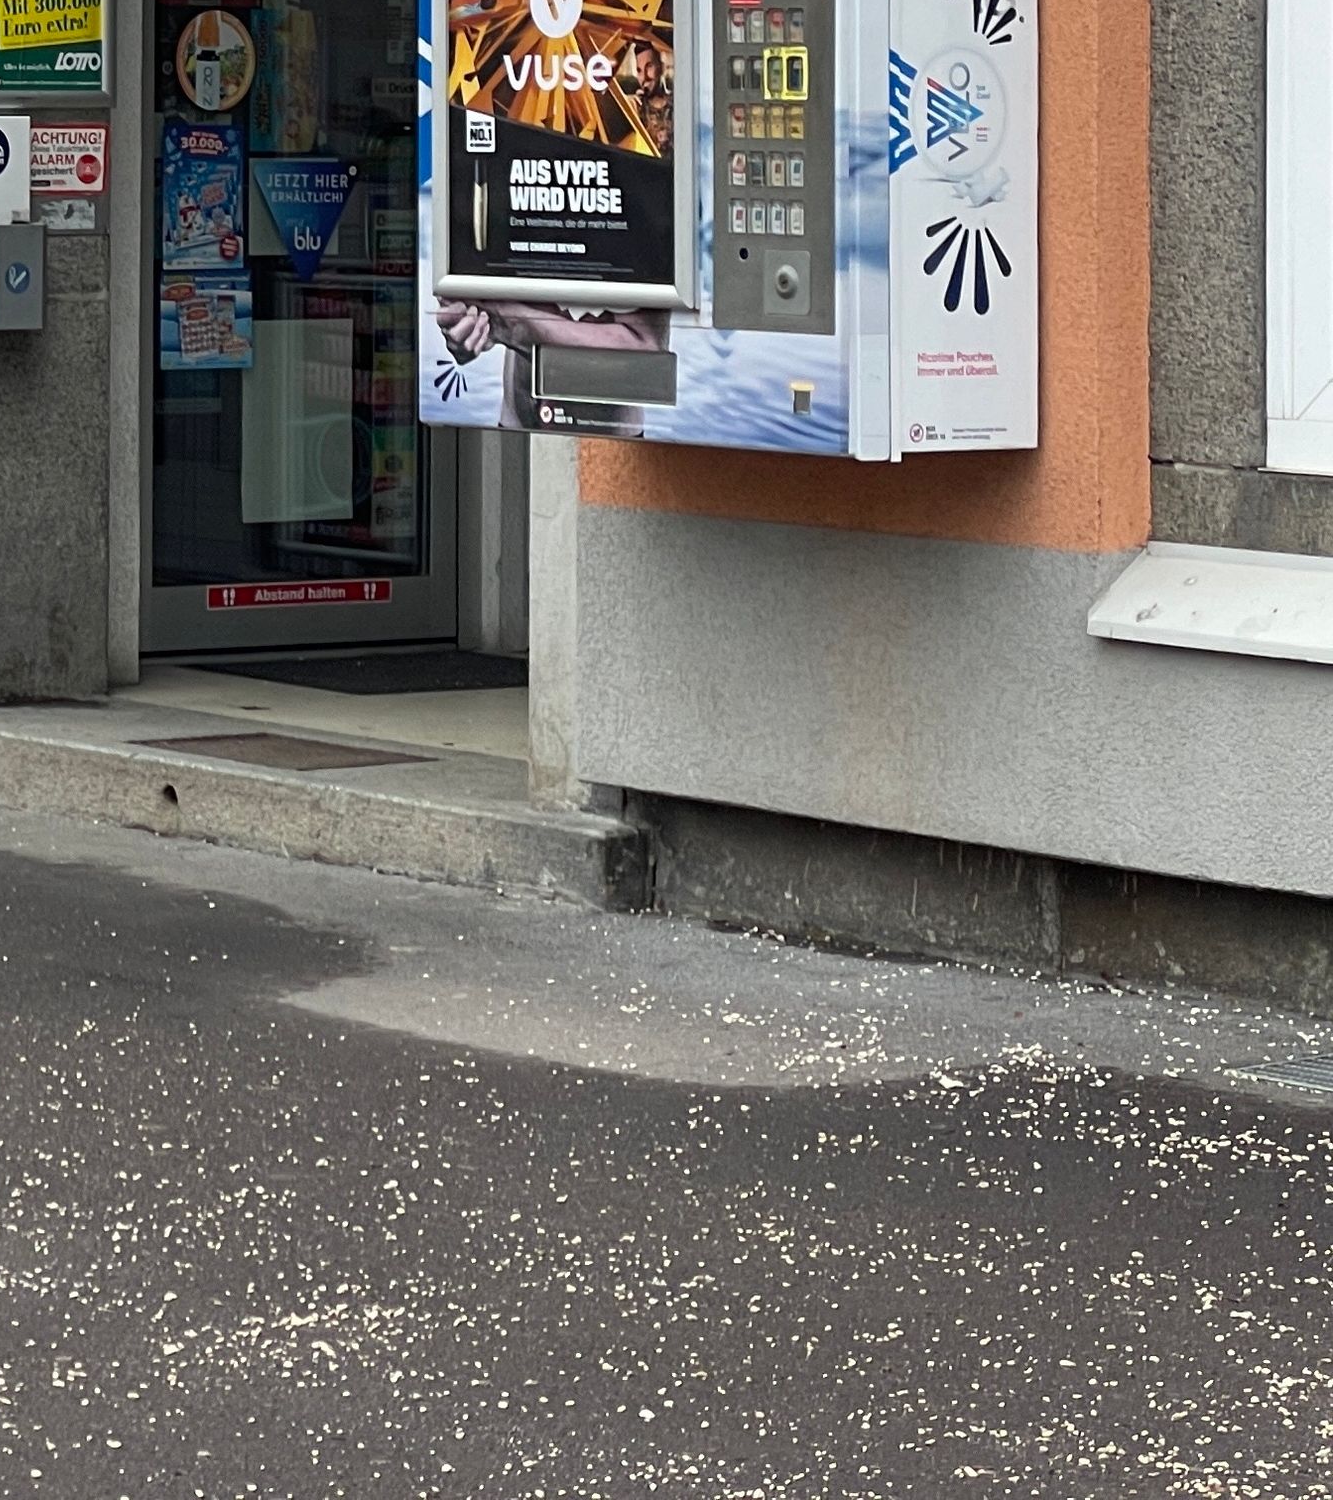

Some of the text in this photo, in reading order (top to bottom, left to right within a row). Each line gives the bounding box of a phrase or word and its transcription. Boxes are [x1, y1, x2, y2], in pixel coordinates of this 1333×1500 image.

[4, 11, 89, 38] Euro extra!
[54, 52, 101, 71] LOTTO
[503, 52, 613, 92] vuse
[31, 131, 102, 145] ACHTUNG!
[469, 128, 493, 142] NO.1
[181, 137, 229, 152] 30.000,-
[31, 154, 75, 165] ALARM
[31, 167, 74, 178] gesichert
[509, 158, 609, 186] AUS VYPE
[266, 173, 348, 189] JETZT HIER
[271, 191, 344, 204] ERHÄLTLICH!
[509, 185, 623, 214] WIRD VUSE
[294, 226, 322, 251] blu
[917, 351, 955, 363] Nicotine
[917, 365, 945, 377] Immer
[947, 366, 965, 377] und
[254, 586, 346, 602] Abstand halten
